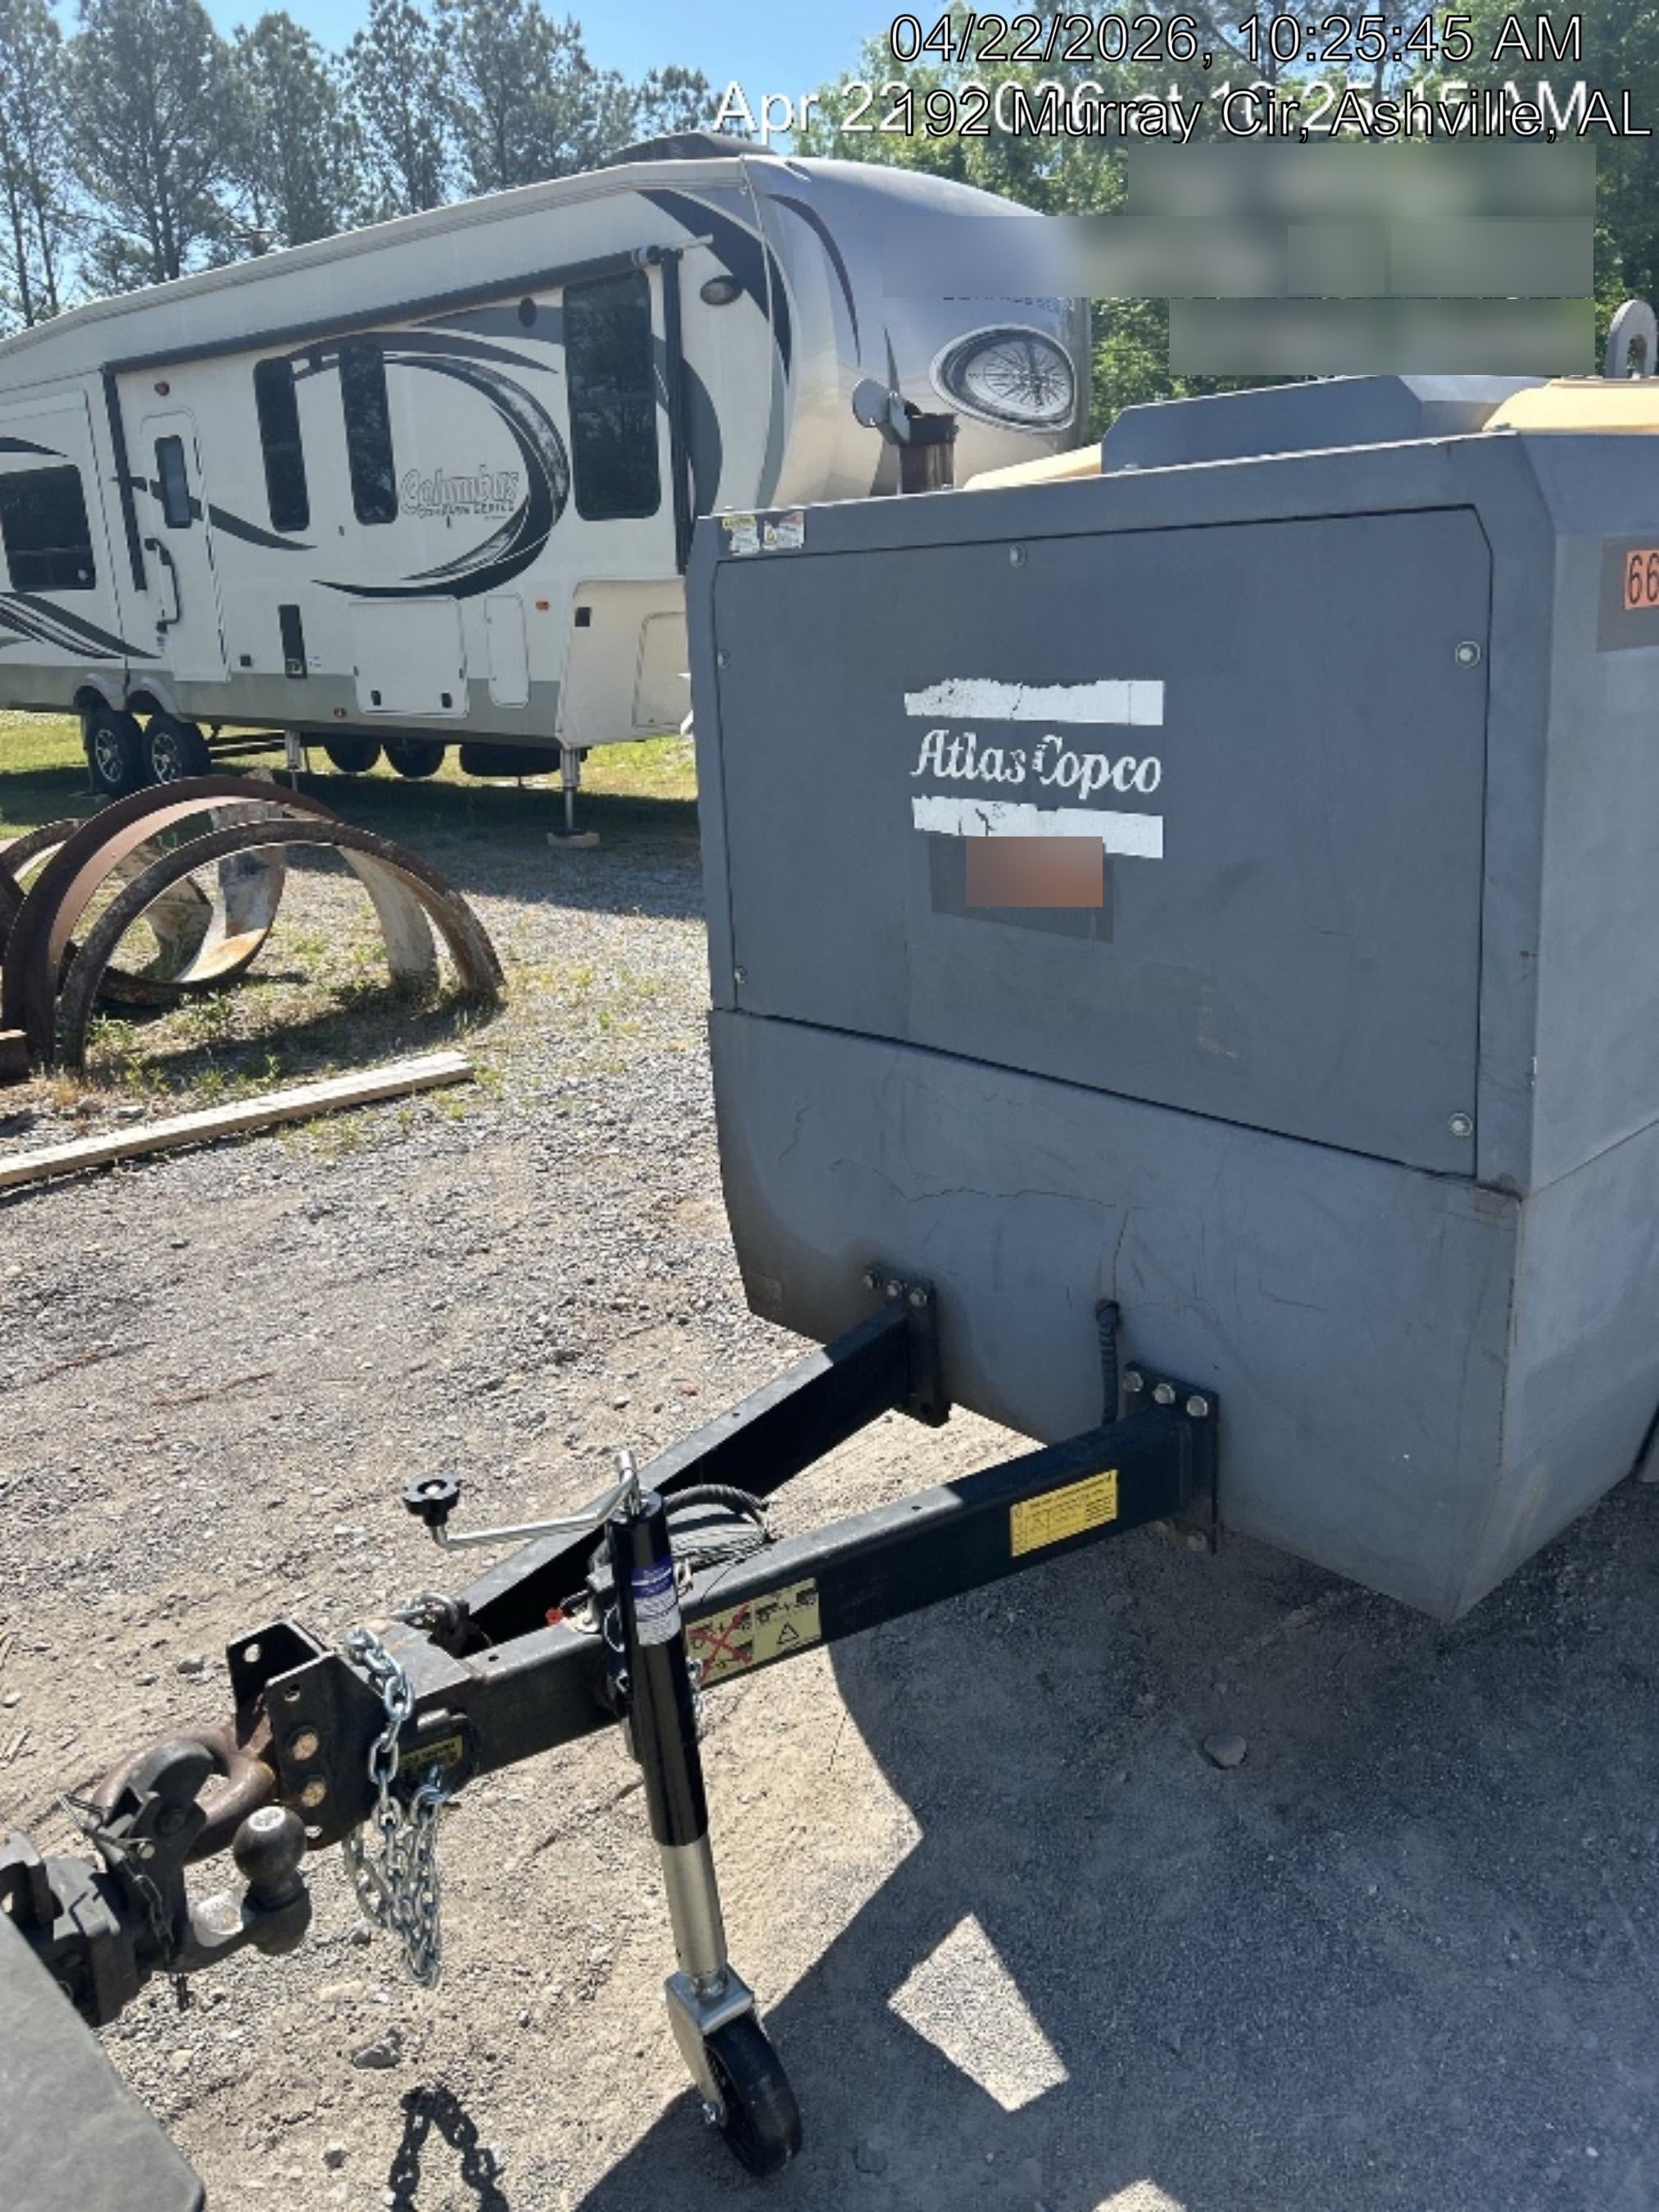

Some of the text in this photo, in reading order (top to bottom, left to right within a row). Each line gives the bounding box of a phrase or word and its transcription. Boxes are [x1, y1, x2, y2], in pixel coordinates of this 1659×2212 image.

[401, 464, 519, 514] Columbus
[909, 728, 1162, 800] Atlas Copco
